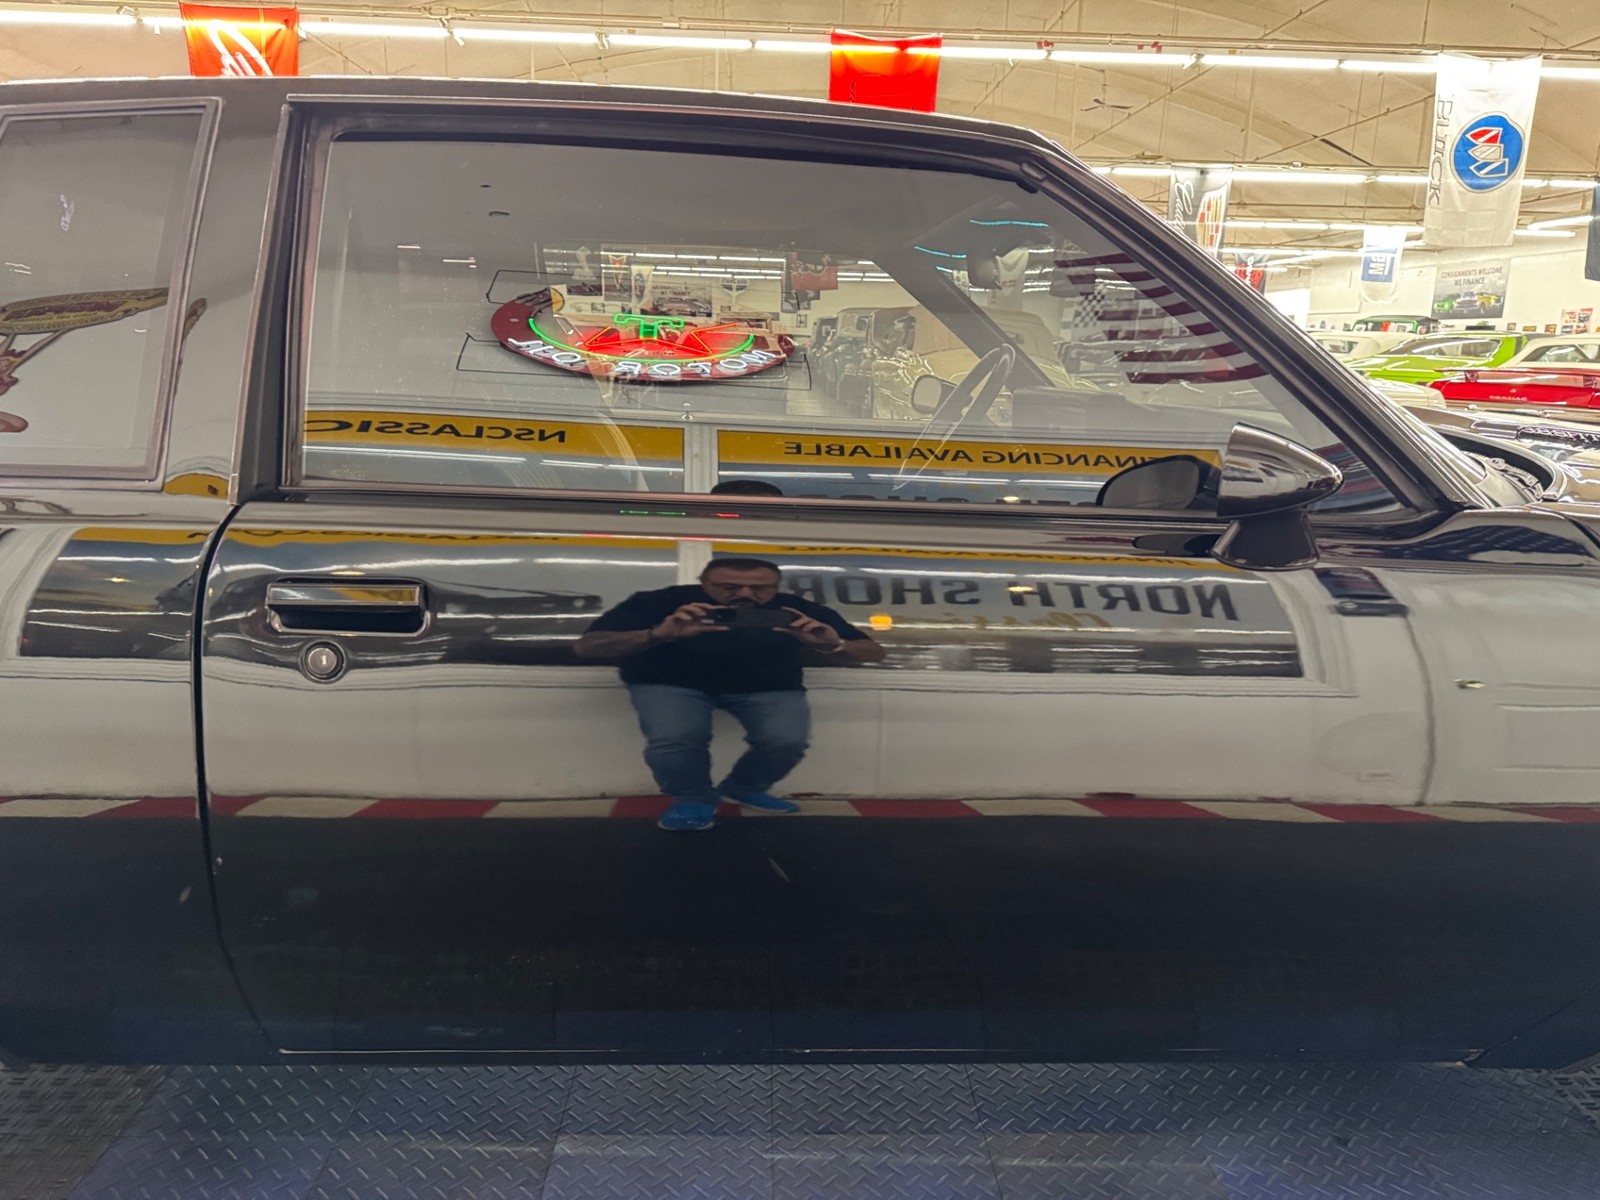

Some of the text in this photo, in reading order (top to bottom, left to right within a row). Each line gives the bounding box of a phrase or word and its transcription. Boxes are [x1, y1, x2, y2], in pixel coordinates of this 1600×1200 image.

[1441, 266, 1503, 279] CONSIGNMENTS WELCOME
[1462, 277, 1486, 285] FINANCE
